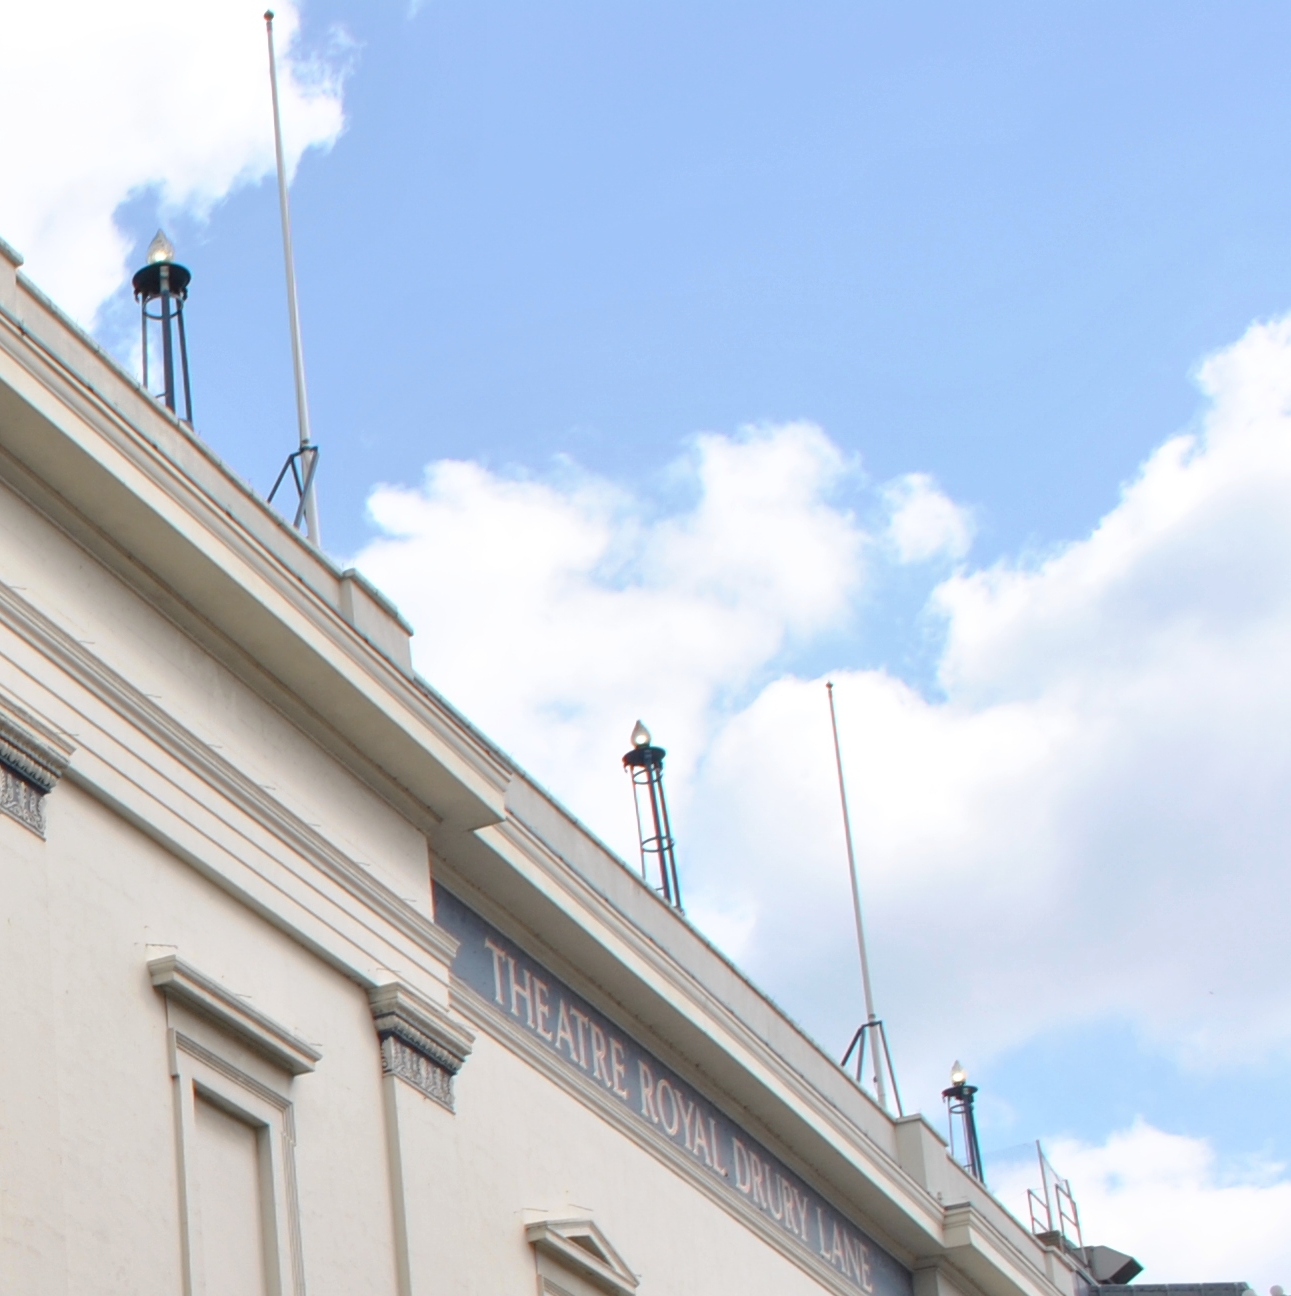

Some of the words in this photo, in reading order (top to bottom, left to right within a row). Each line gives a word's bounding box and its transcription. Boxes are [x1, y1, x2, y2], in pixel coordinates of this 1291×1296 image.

[484, 938, 628, 1099] THEATRE
[638, 1060, 729, 1178] ROYAL
[732, 1138, 810, 1242] DRURY
[816, 1206, 875, 1294] LANE
